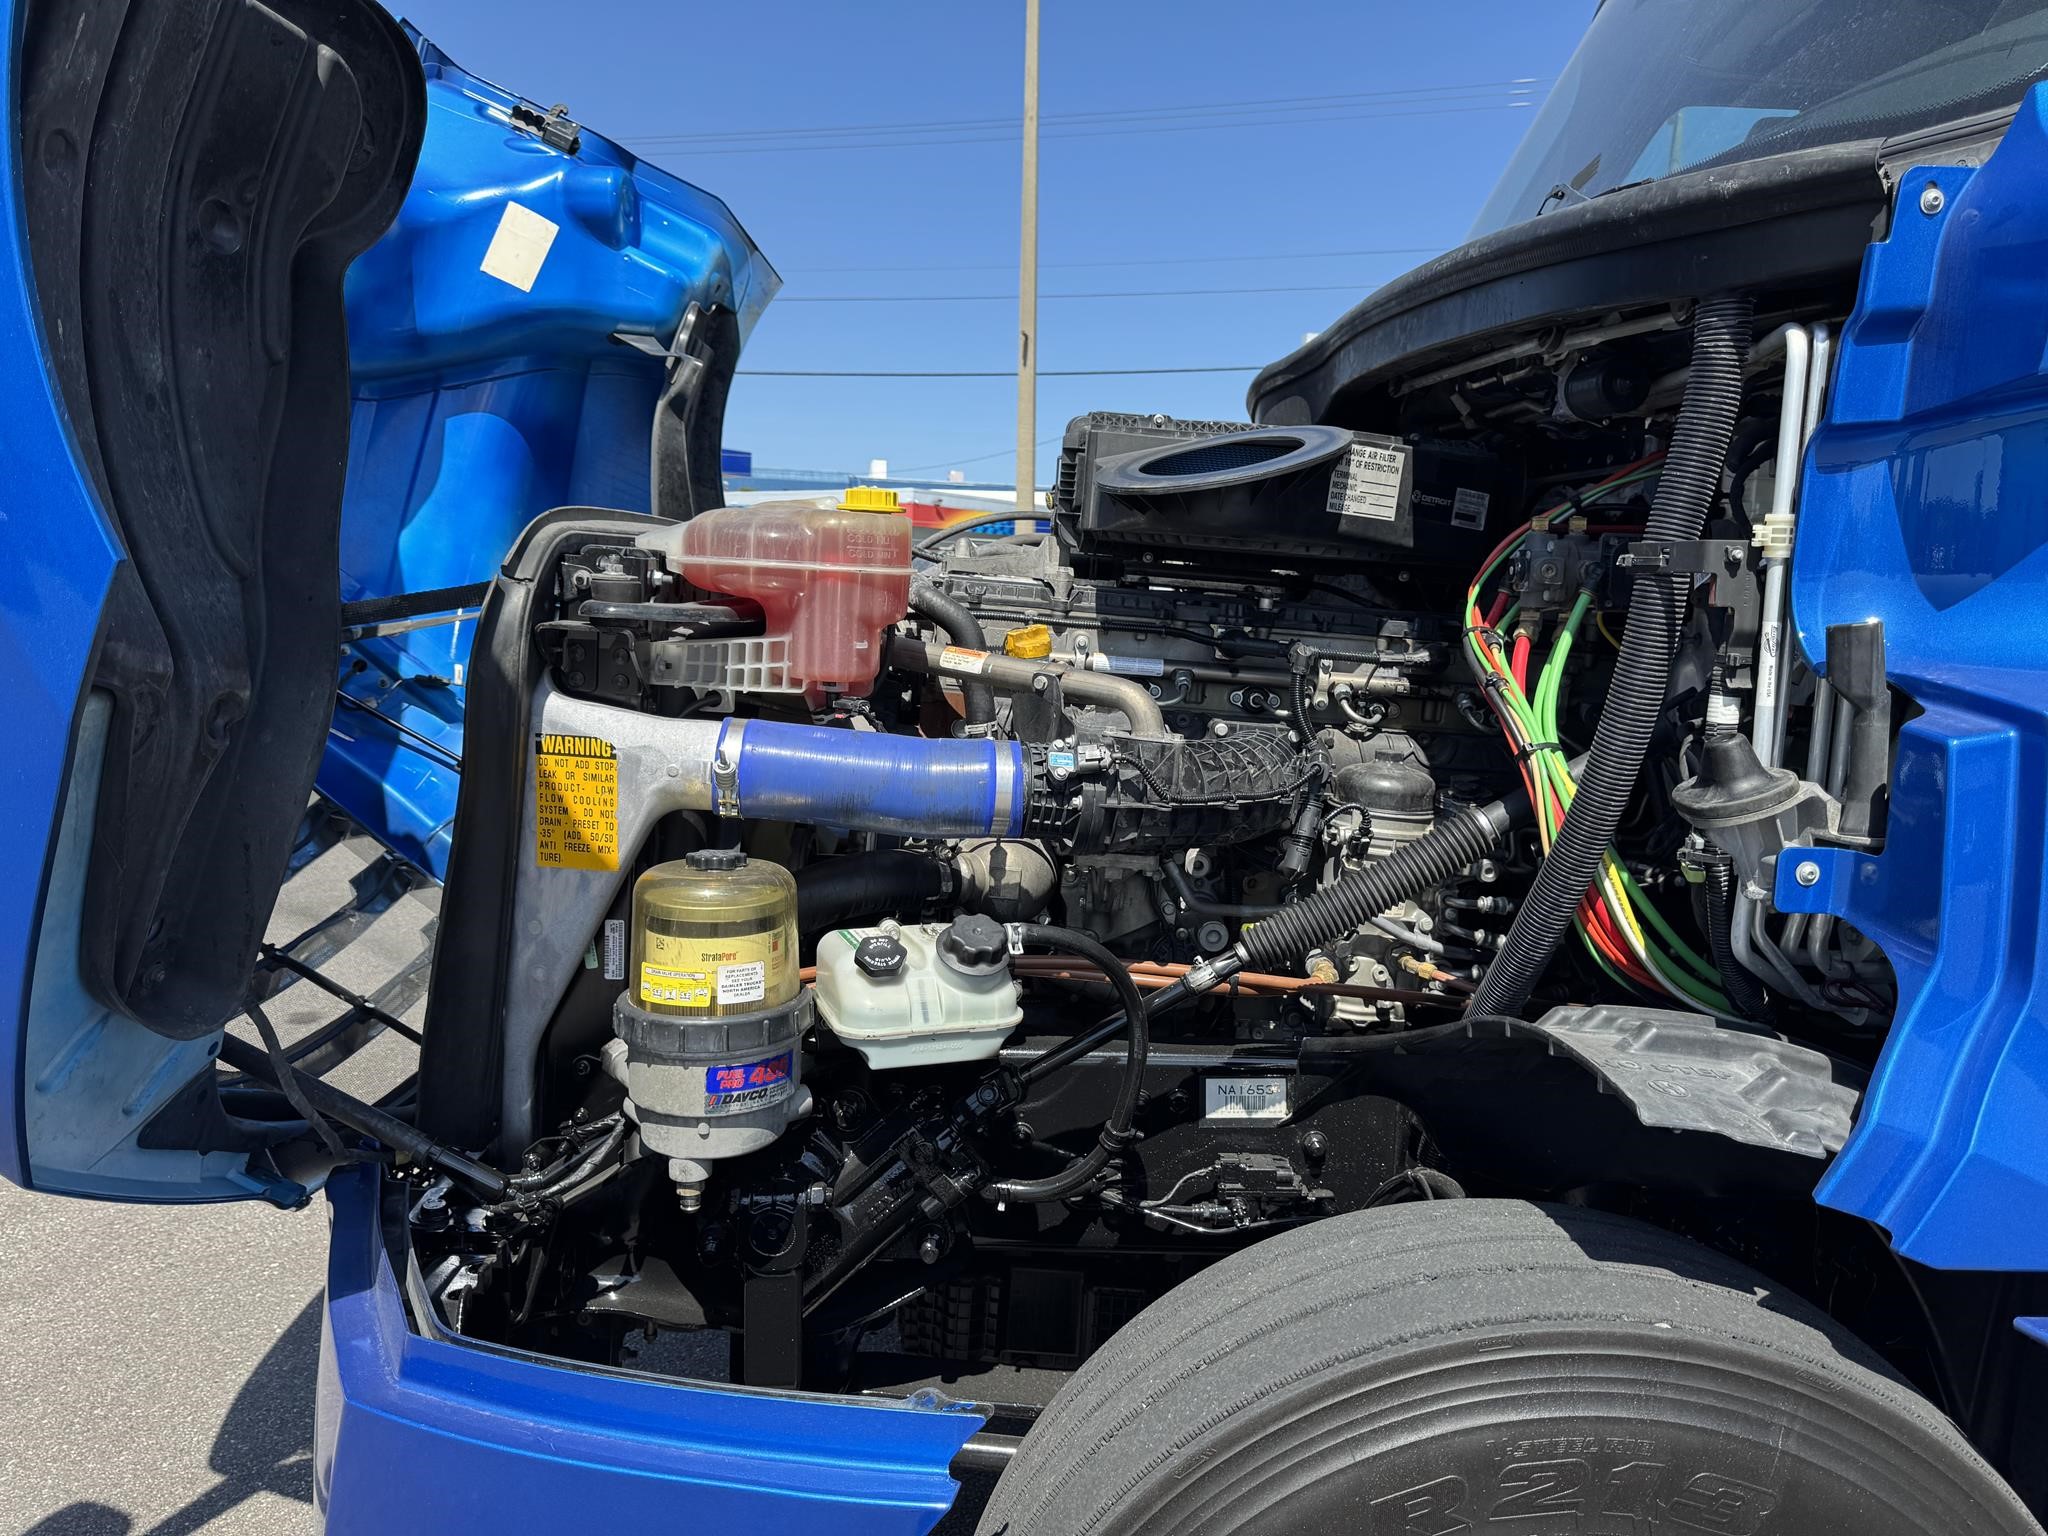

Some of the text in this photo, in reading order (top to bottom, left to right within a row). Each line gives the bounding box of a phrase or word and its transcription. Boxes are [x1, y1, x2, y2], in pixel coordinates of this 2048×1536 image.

[1368, 452, 1378, 460] AIR
[1380, 452, 1396, 463] FILTER
[1356, 460, 1362, 468] OF
[1364, 462, 1399, 475] RESTRICTION
[1330, 491, 1367, 504] DATE CHANGED
[1422, 494, 1452, 506] DETROIT
[1328, 502, 1351, 512] MILEAGE
[542, 735, 612, 757] WARNING
[539, 758, 548, 766] DO
[555, 759, 568, 768] NOT
[575, 760, 590, 769] ADD
[539, 770, 614, 783] LEAK OR SIMILAR
[540, 782, 614, 796] PRODUCT- LOW
[540, 793, 614, 808] FLOW COOLING
[540, 805, 568, 815] SYSTEM
[584, 808, 593, 817] DO
[600, 810, 614, 819] NOT
[540, 817, 561, 826] DRAIN
[573, 819, 599, 830] PRESET
[605, 822, 614, 831] TO
[590, 832, 614, 843] 50/50
[540, 841, 615, 855] ANTI FREEZE MIX-
[702, 952, 736, 962] StrataPore
[717, 1068, 745, 1080] FUEL
[720, 1078, 745, 1089] PRO
[721, 1088, 768, 1104] DAVCO
